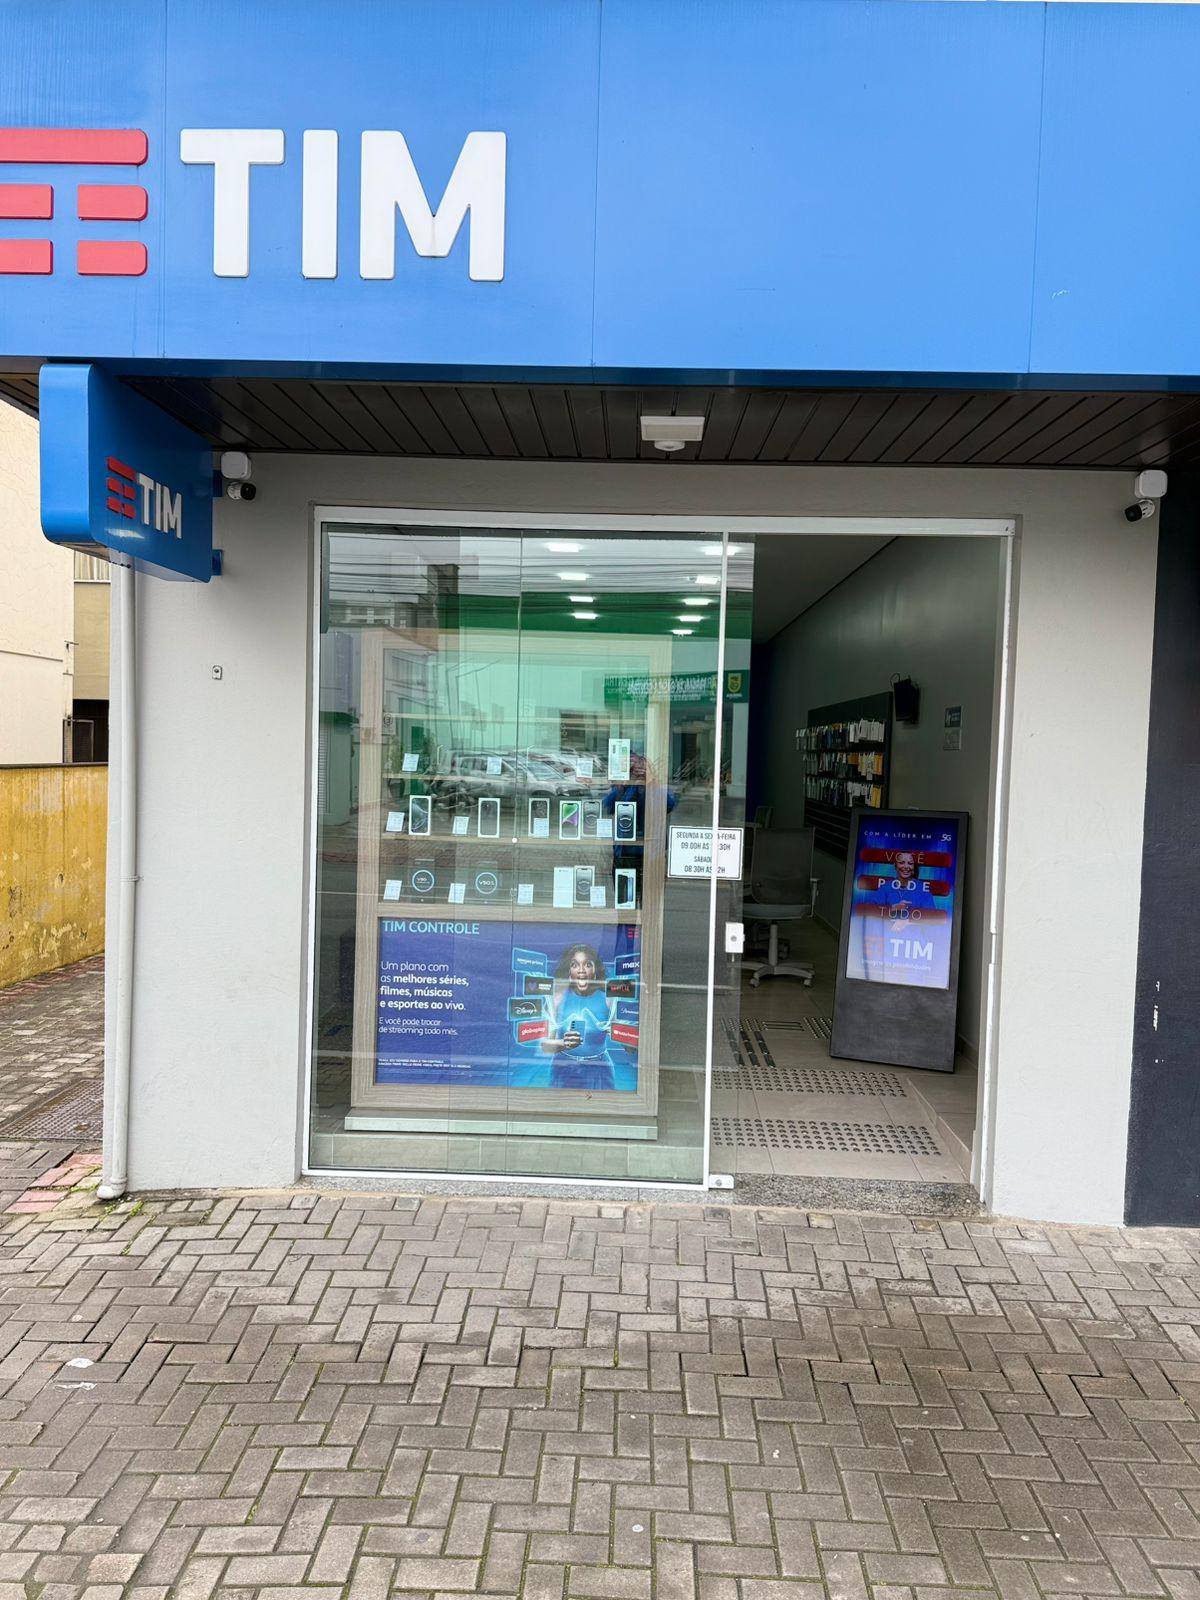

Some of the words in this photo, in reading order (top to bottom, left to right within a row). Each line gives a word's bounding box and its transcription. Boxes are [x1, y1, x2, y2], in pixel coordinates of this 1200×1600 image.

[180, 128, 507, 281] TIM
[136, 472, 182, 539] TIM
[878, 878, 930, 892] PODE
[880, 906, 922, 920] TUDO
[382, 921, 406, 932] TIM
[409, 922, 480, 934] CONTROLE
[890, 939, 934, 960] TIM
[381, 961, 398, 970] Um
[400, 961, 426, 972] plano
[428, 964, 449, 972] com
[622, 961, 640, 969] max
[380, 975, 391, 983] as
[393, 974, 437, 984] melhores
[439, 974, 469, 987] séries,
[380, 986, 412, 997] filmes,
[414, 987, 453, 997] músicas
[380, 1000, 386, 1008] e
[388, 1000, 429, 1010] esportes
[445, 1000, 466, 1010] vivo.
[402, 1018, 420, 1026] pode
[388, 1027, 423, 1036] streaming
